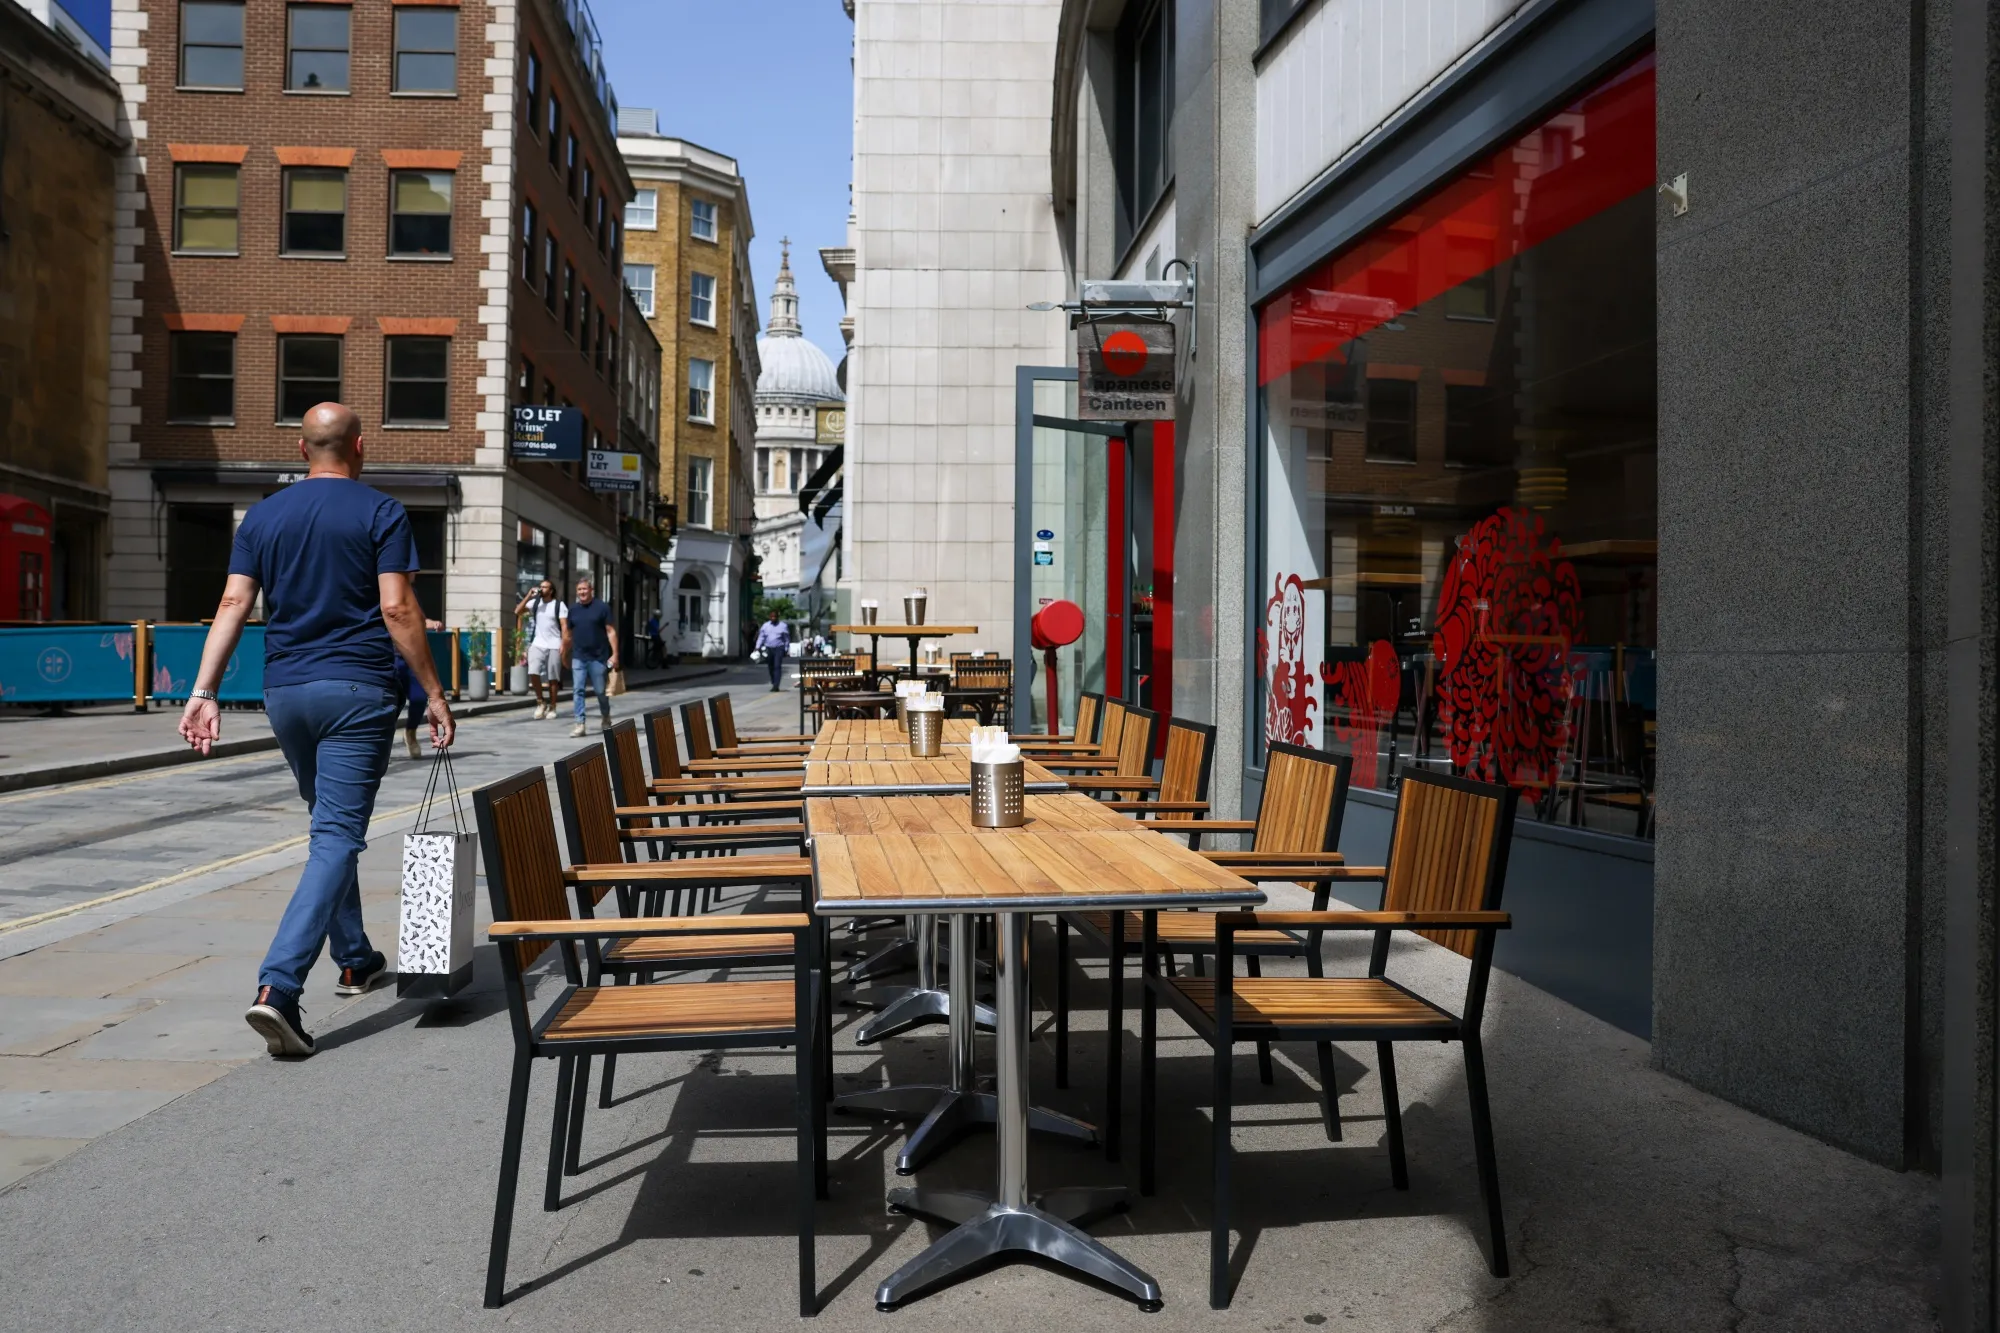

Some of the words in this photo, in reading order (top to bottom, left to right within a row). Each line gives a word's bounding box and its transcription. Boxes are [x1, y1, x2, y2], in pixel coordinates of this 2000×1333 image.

[1089, 378, 1172, 393] apanese
[1088, 397, 1166, 411] Canteen
[513, 407, 534, 420] TO
[538, 408, 562, 422] LET
[514, 431, 543, 442] Retail
[591, 452, 604, 461] TO
[590, 461, 608, 470] LET
[277, 473, 290, 483] JOE
